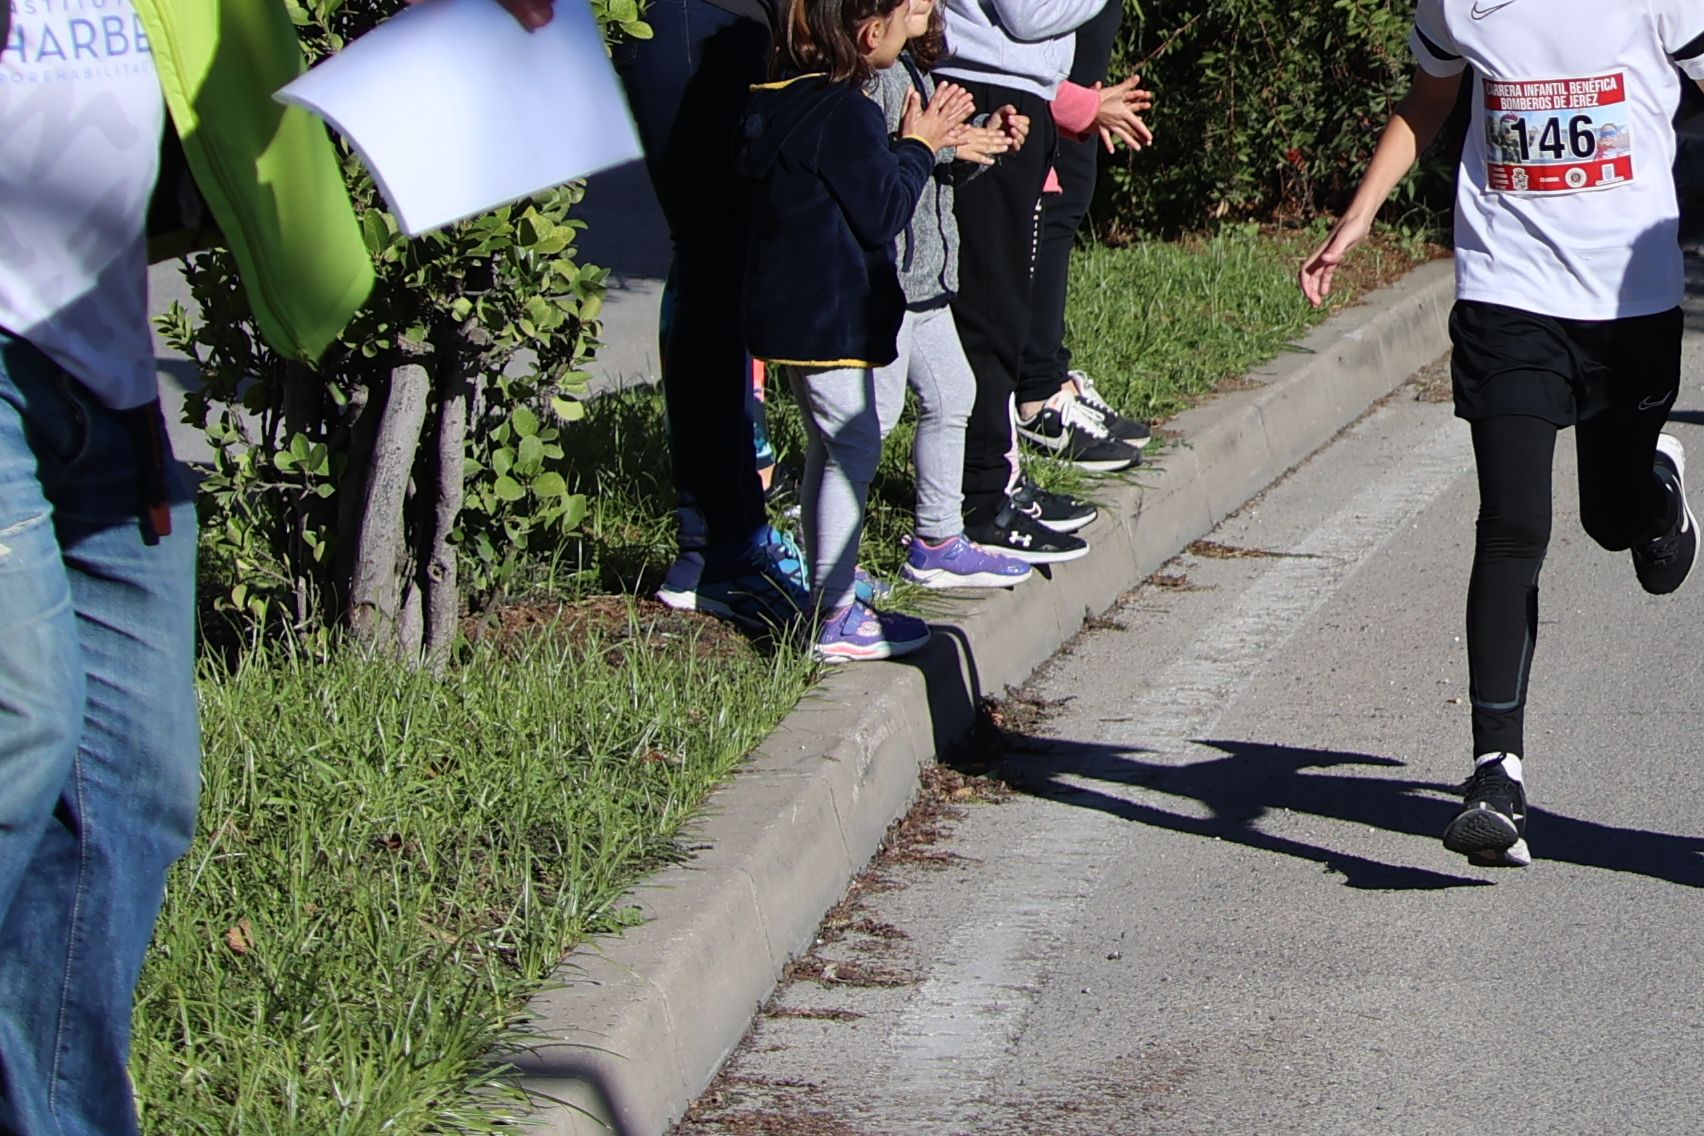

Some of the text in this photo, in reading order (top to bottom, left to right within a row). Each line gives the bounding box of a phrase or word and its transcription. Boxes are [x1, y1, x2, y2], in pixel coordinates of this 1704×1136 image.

[1524, 82, 1568, 96] INFANTIL
[1569, 76, 1617, 94] BENÉFICA
[1500, 93, 1599, 110] BOMBEROS DE JEREZ
[1511, 115, 1597, 161] 146
